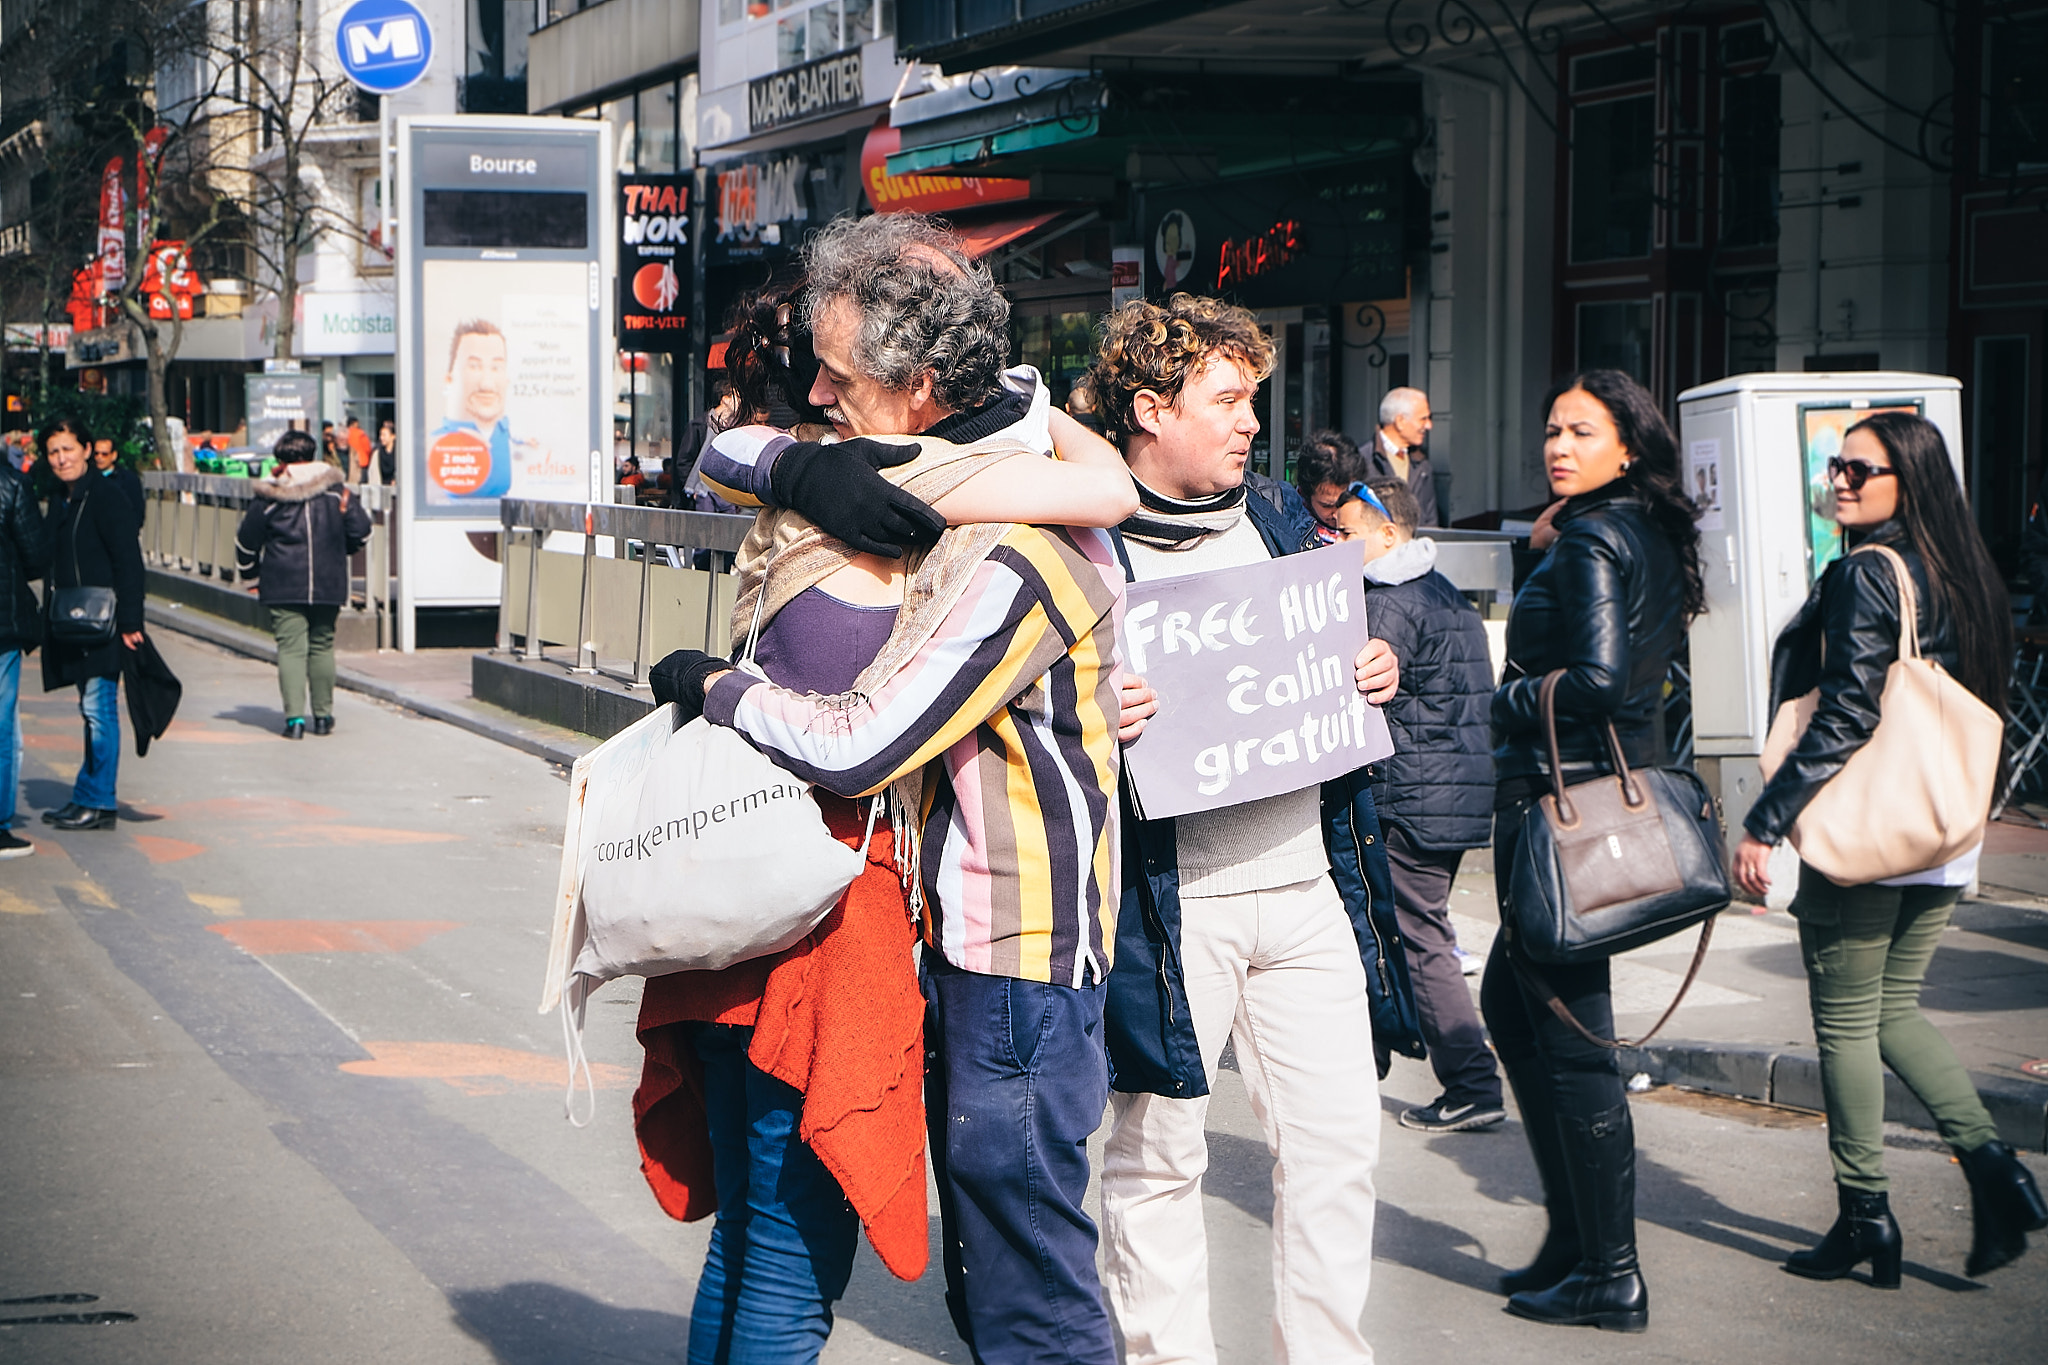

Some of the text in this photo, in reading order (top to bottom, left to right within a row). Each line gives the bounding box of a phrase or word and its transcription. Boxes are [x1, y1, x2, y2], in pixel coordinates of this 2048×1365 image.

[348, 18, 419, 64] M
[752, 54, 861, 126] MARC BARTIER
[470, 154, 538, 173] Bourse
[624, 185, 689, 215] THAI
[624, 215, 688, 244] WOK
[153, 299, 189, 311] Quck
[323, 314, 395, 334] Mobista
[1124, 572, 1349, 674] FREE HUG
[1194, 690, 1366, 796] gratuit
